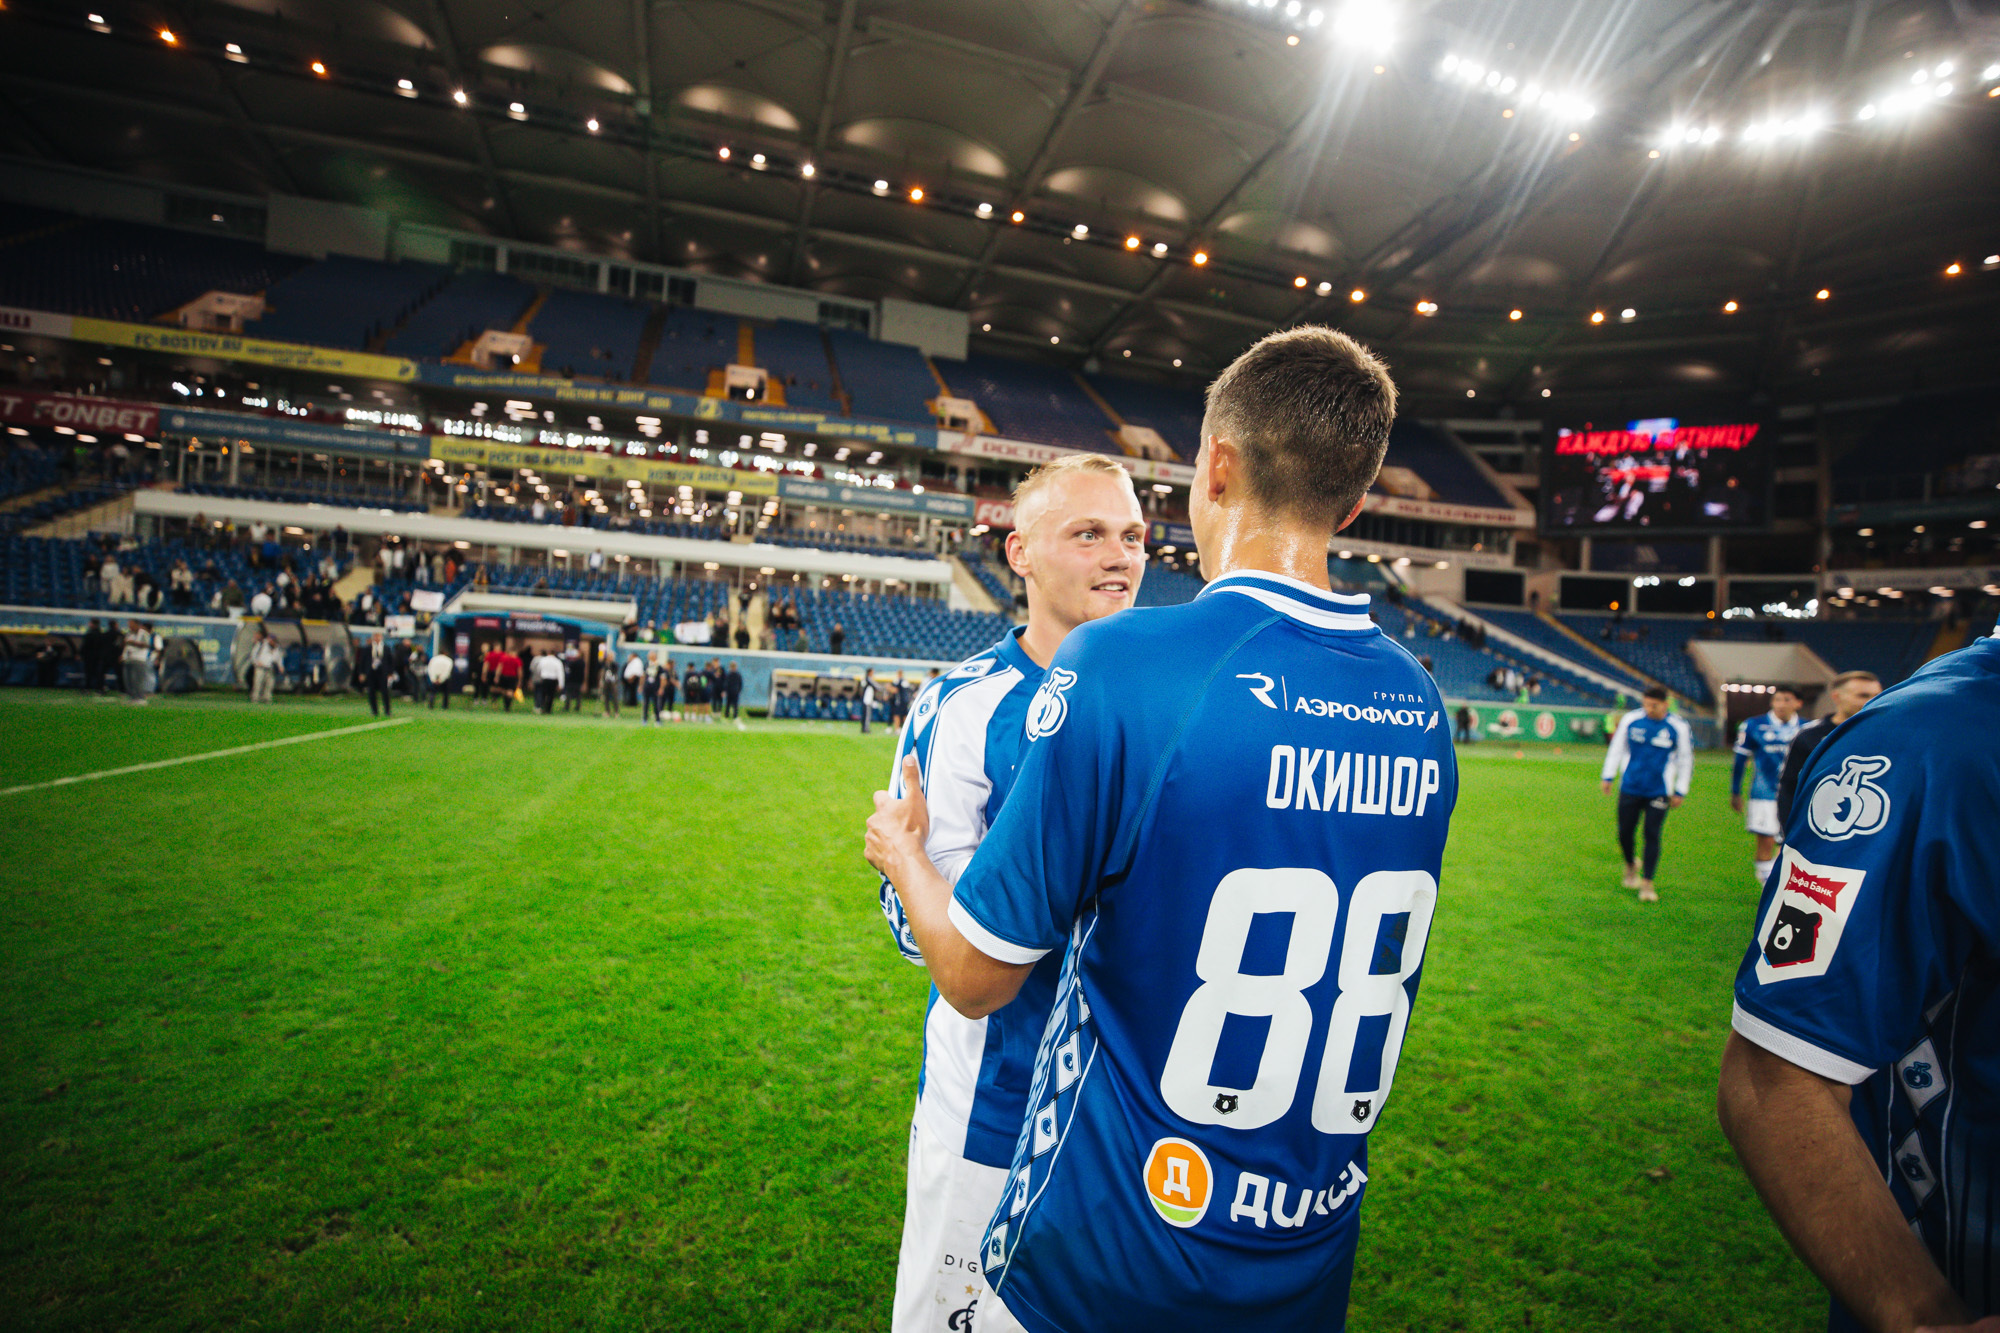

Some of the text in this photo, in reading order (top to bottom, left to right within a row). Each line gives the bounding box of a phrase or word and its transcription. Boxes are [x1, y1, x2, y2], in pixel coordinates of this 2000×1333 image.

[1294, 696, 1426, 727] АЭРОФЛОТ
[1373, 691, 1424, 704] ГРУППА
[1266, 744, 1440, 817] ОКИШОР
[1809, 881, 1833, 898] Банк
[1160, 867, 1438, 1135] 88
